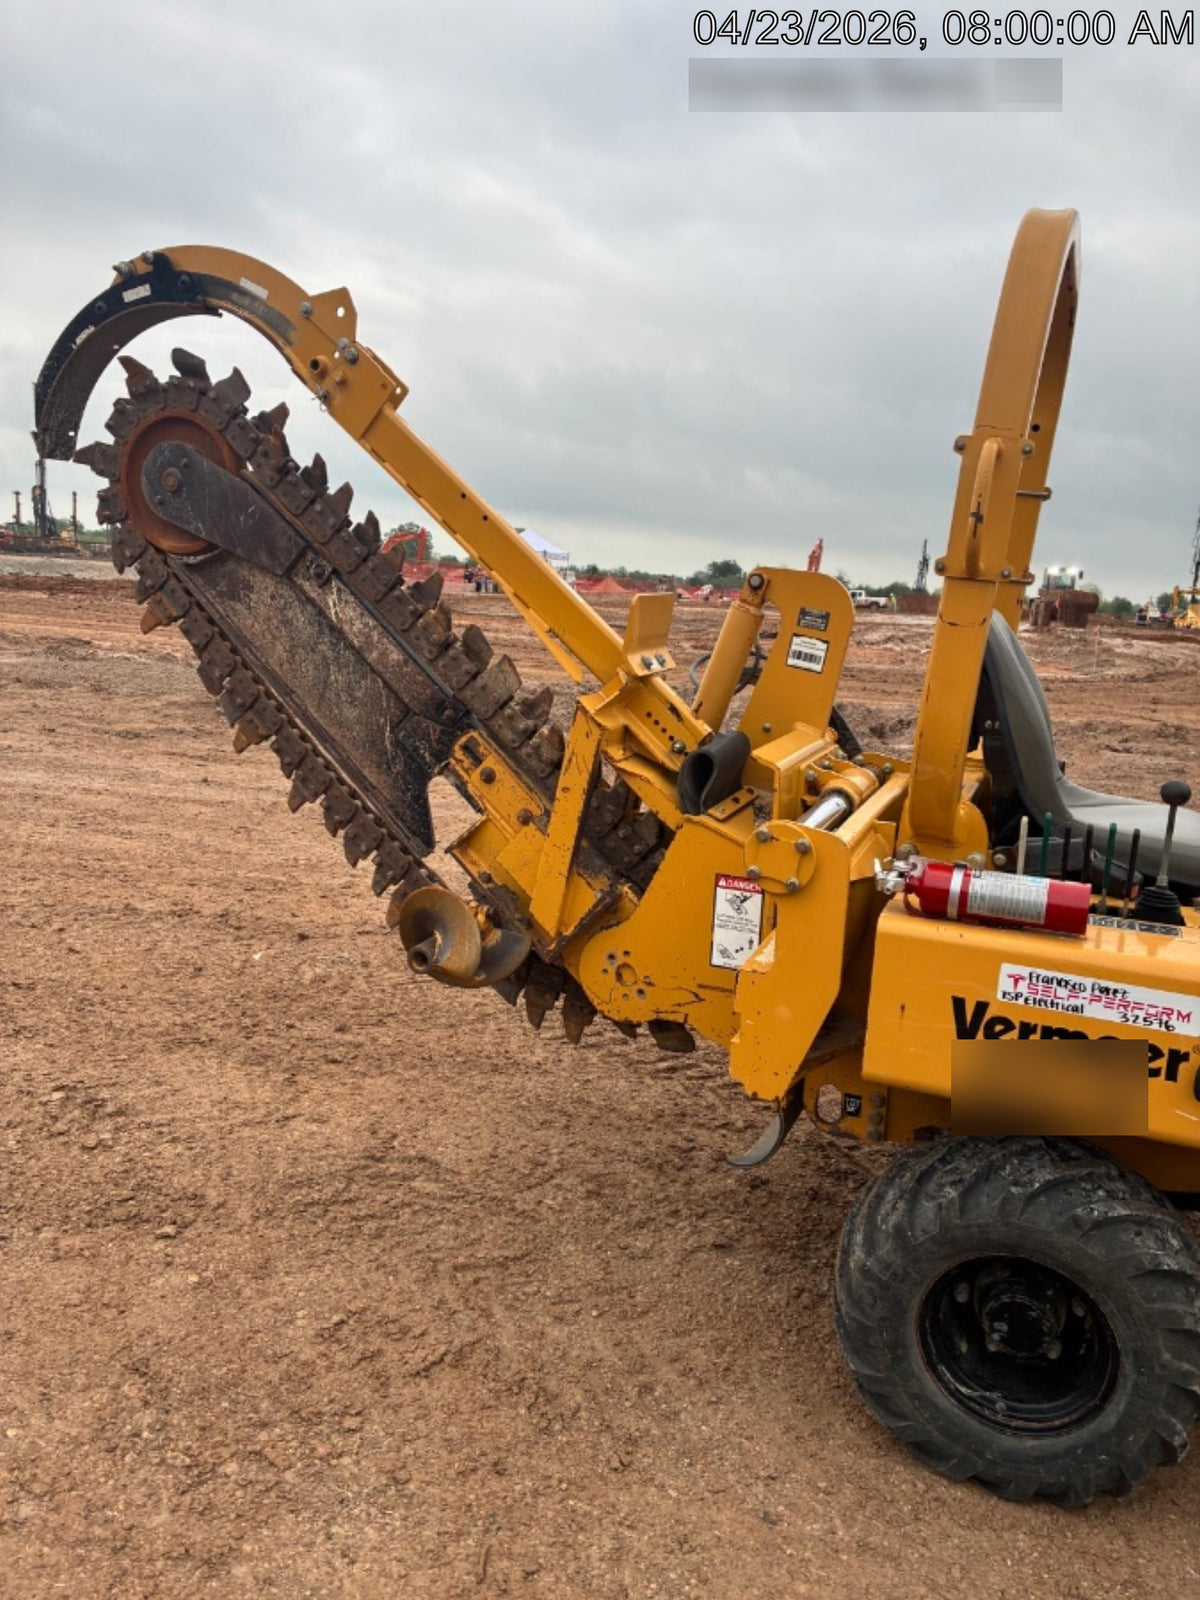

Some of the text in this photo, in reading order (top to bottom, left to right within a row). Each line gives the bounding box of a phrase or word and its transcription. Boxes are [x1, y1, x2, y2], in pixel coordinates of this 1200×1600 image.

[727, 879, 761, 892] DANGER
[1024, 995, 1084, 1014] Electrical
[951, 995, 1190, 1083] Verer
